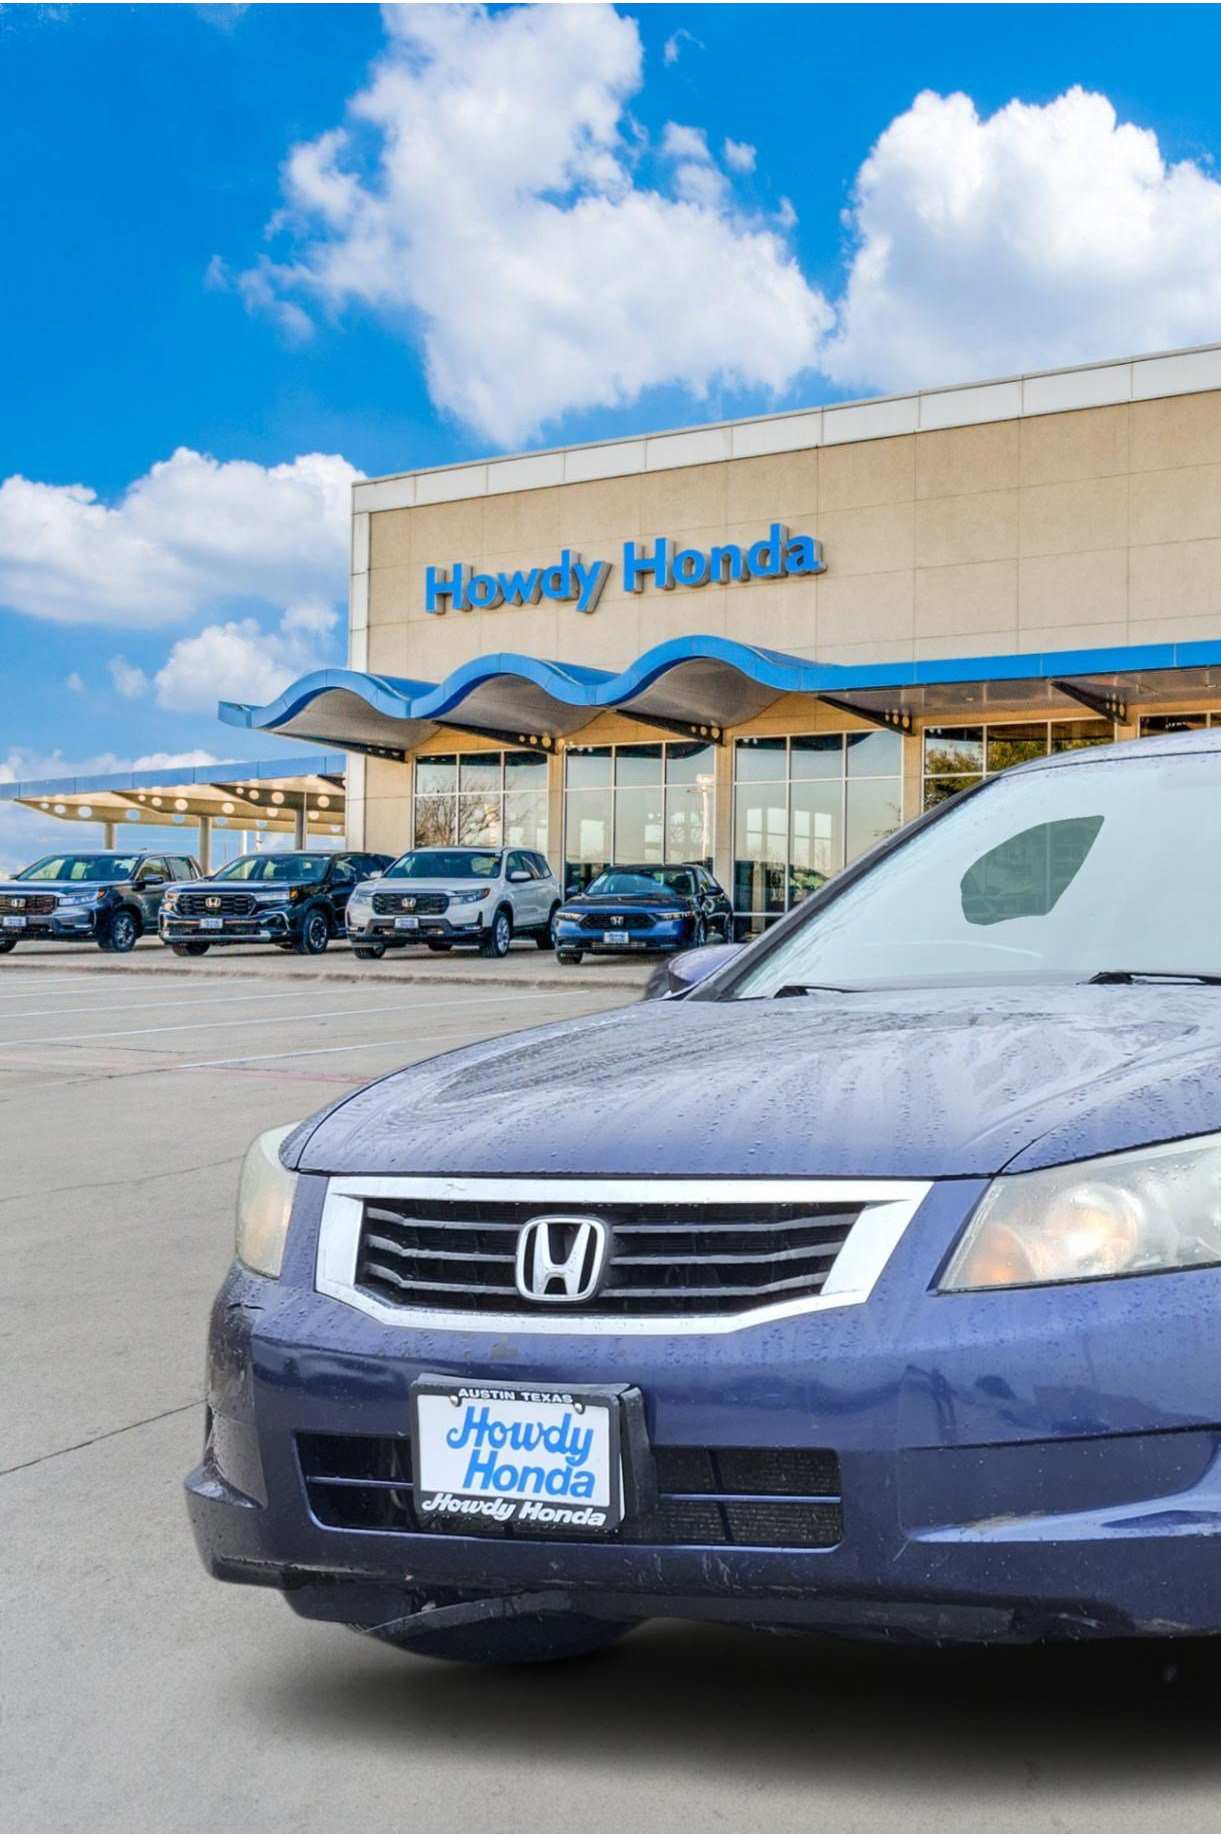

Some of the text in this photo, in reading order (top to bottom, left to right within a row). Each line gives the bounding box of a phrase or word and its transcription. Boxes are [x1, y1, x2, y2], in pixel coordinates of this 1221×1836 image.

[425, 523, 827, 615] Howdy Honda
[458, 1387, 574, 1405] AUSTIN TEXAS
[446, 1405, 594, 1467] Howdy
[462, 1448, 597, 1498] Honda
[421, 1492, 608, 1526] Howdy Honda
